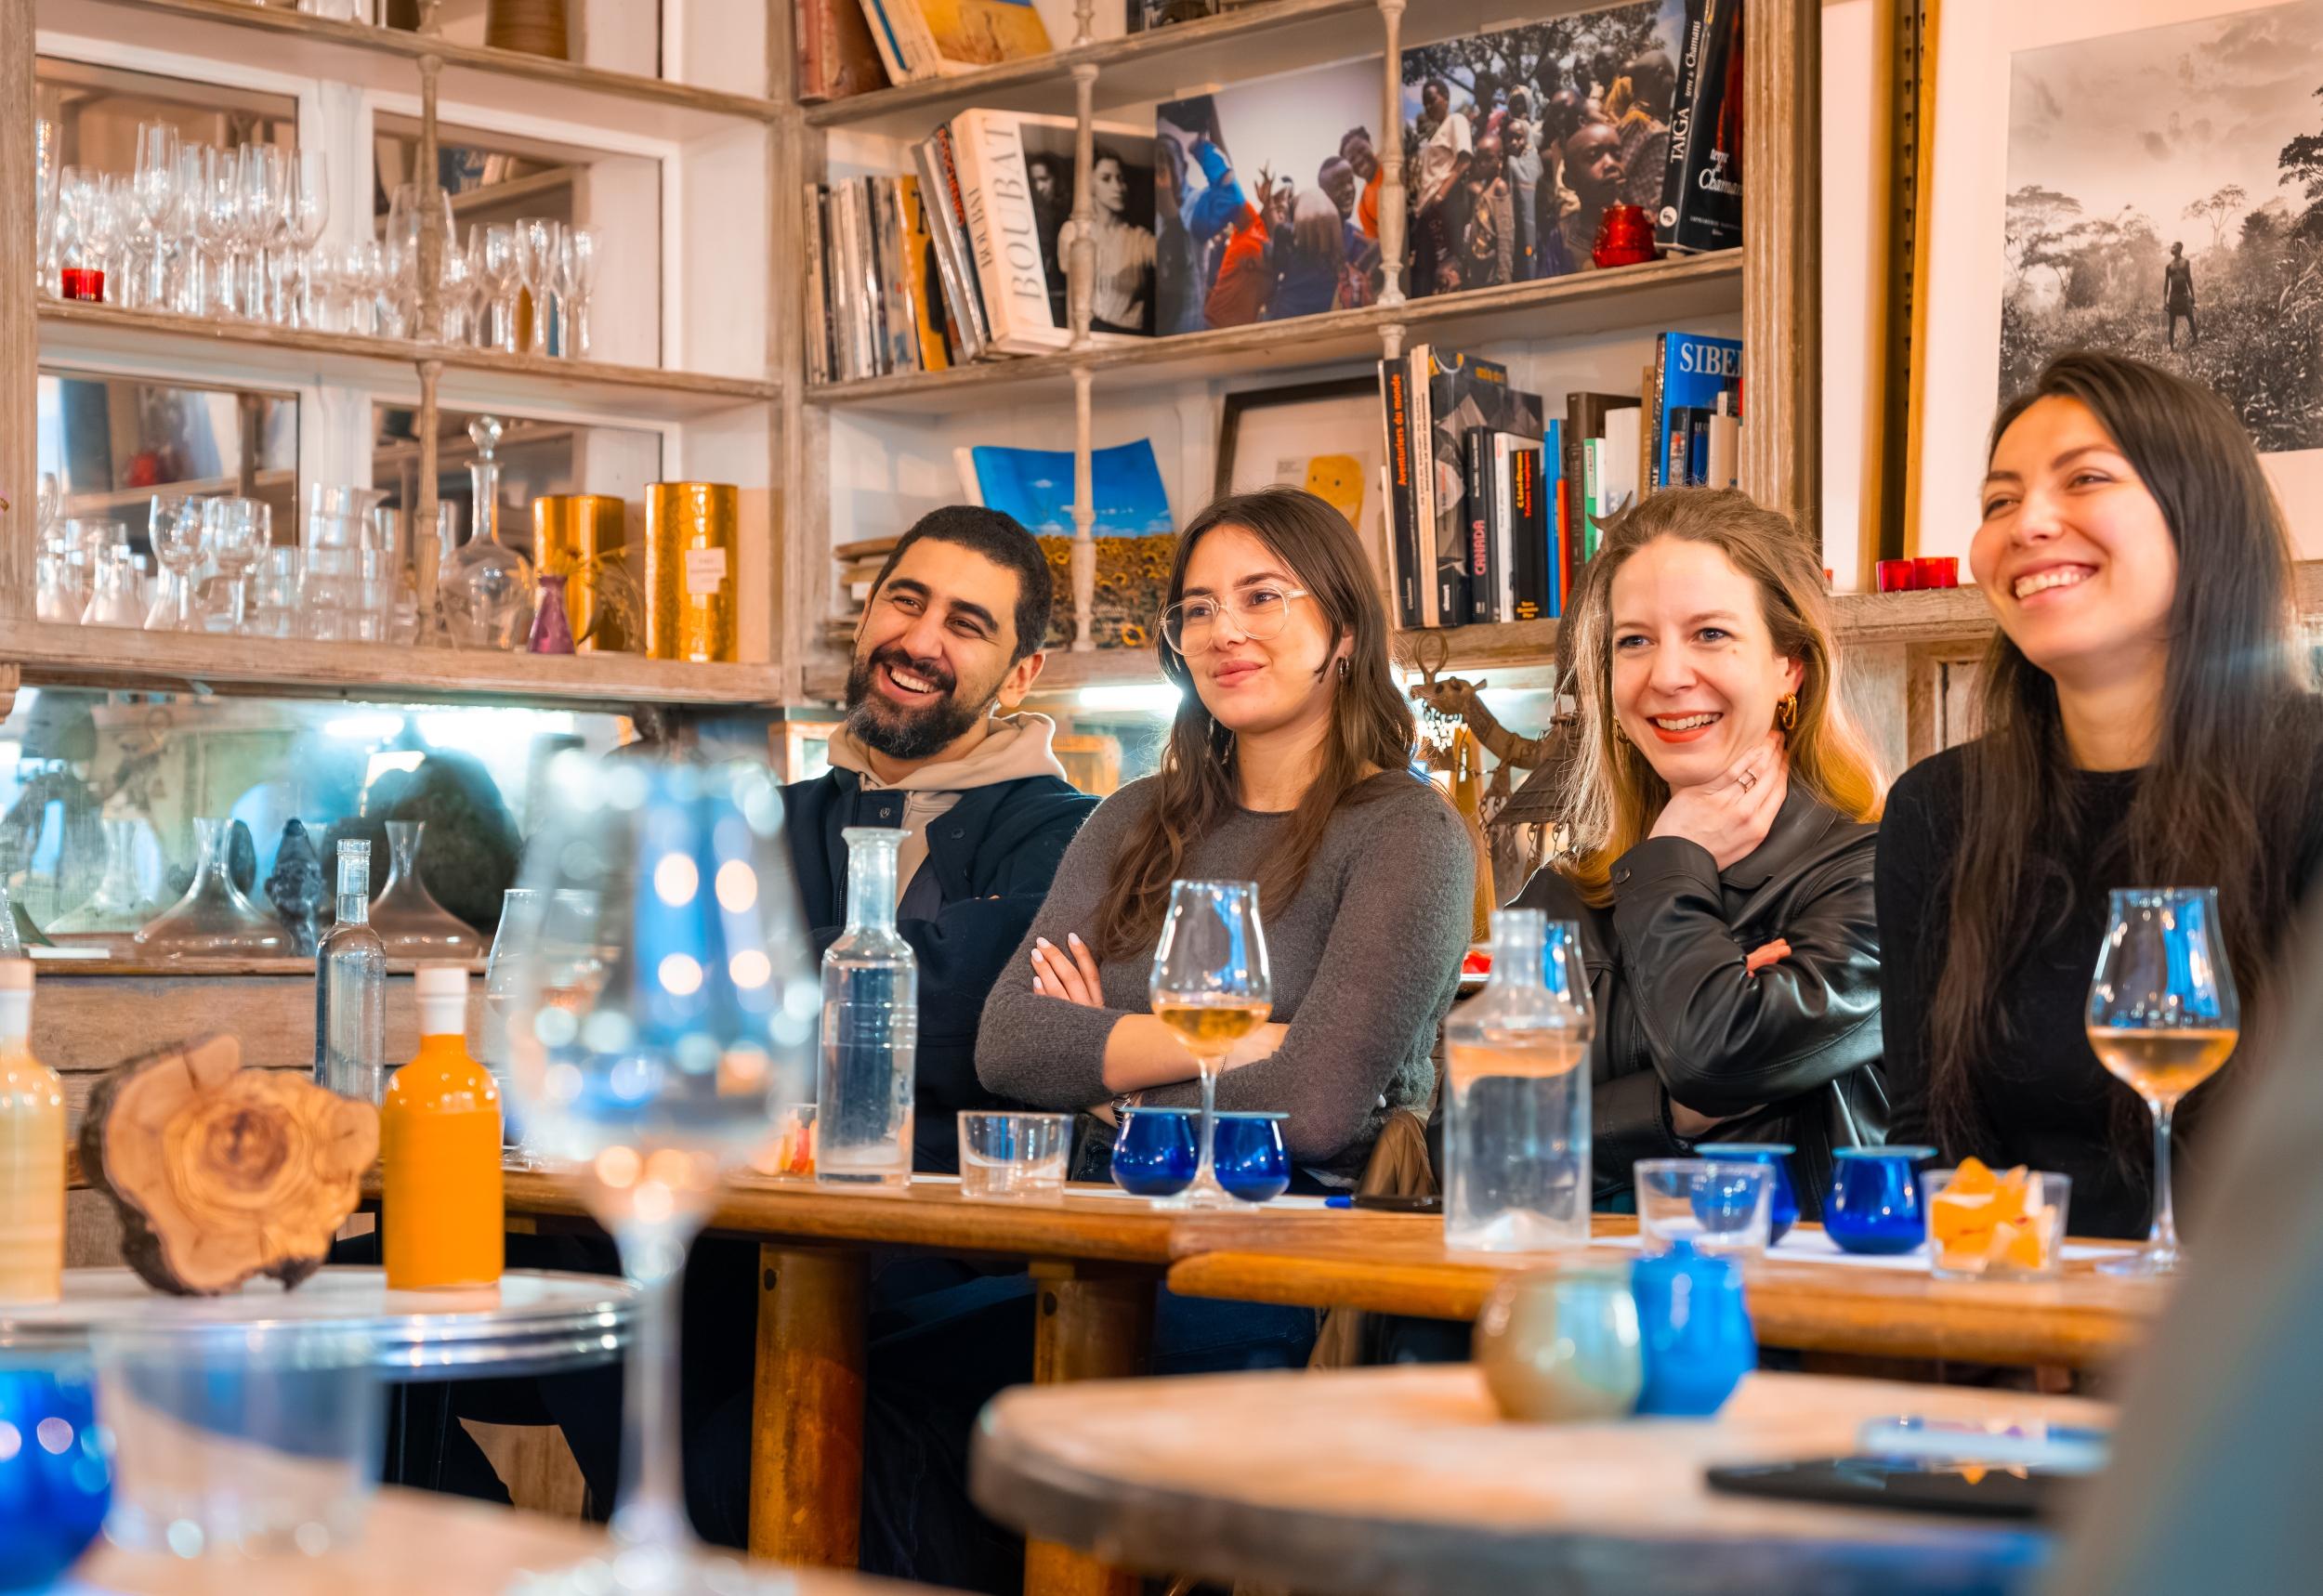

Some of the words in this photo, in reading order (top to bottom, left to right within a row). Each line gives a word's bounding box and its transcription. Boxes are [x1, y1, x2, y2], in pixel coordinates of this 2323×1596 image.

[1670, 107, 1690, 164] TAIGA
[1685, 20, 1701, 68] Chamans
[967, 188, 993, 268] BOUBAT
[982, 117, 1043, 299] BOUBAT
[1390, 373, 1402, 410] monde
[1393, 411, 1404, 425] du
[1395, 426, 1408, 486] Aventuriers
[1472, 519, 1487, 575] CANADA
